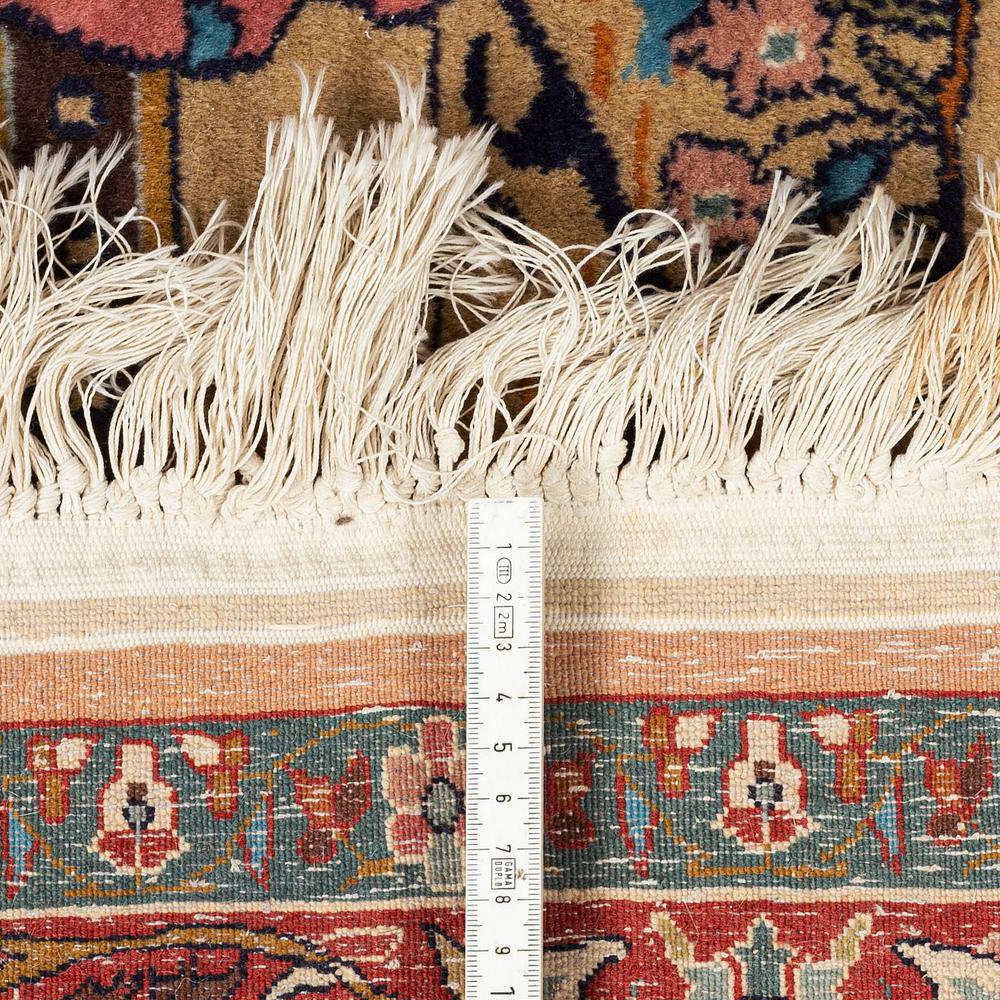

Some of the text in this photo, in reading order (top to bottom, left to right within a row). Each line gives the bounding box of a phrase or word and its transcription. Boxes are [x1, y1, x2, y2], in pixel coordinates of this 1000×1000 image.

[496, 593, 512, 601] 2
[496, 643, 512, 652] 3
[495, 693, 512, 702] 4
[493, 742, 513, 752] 5
[495, 794, 512, 803] 6
[495, 844, 512, 853] 7
[504, 861, 513, 886] GAMA
[495, 895, 512, 904] 8
[494, 946, 511, 955] 9
